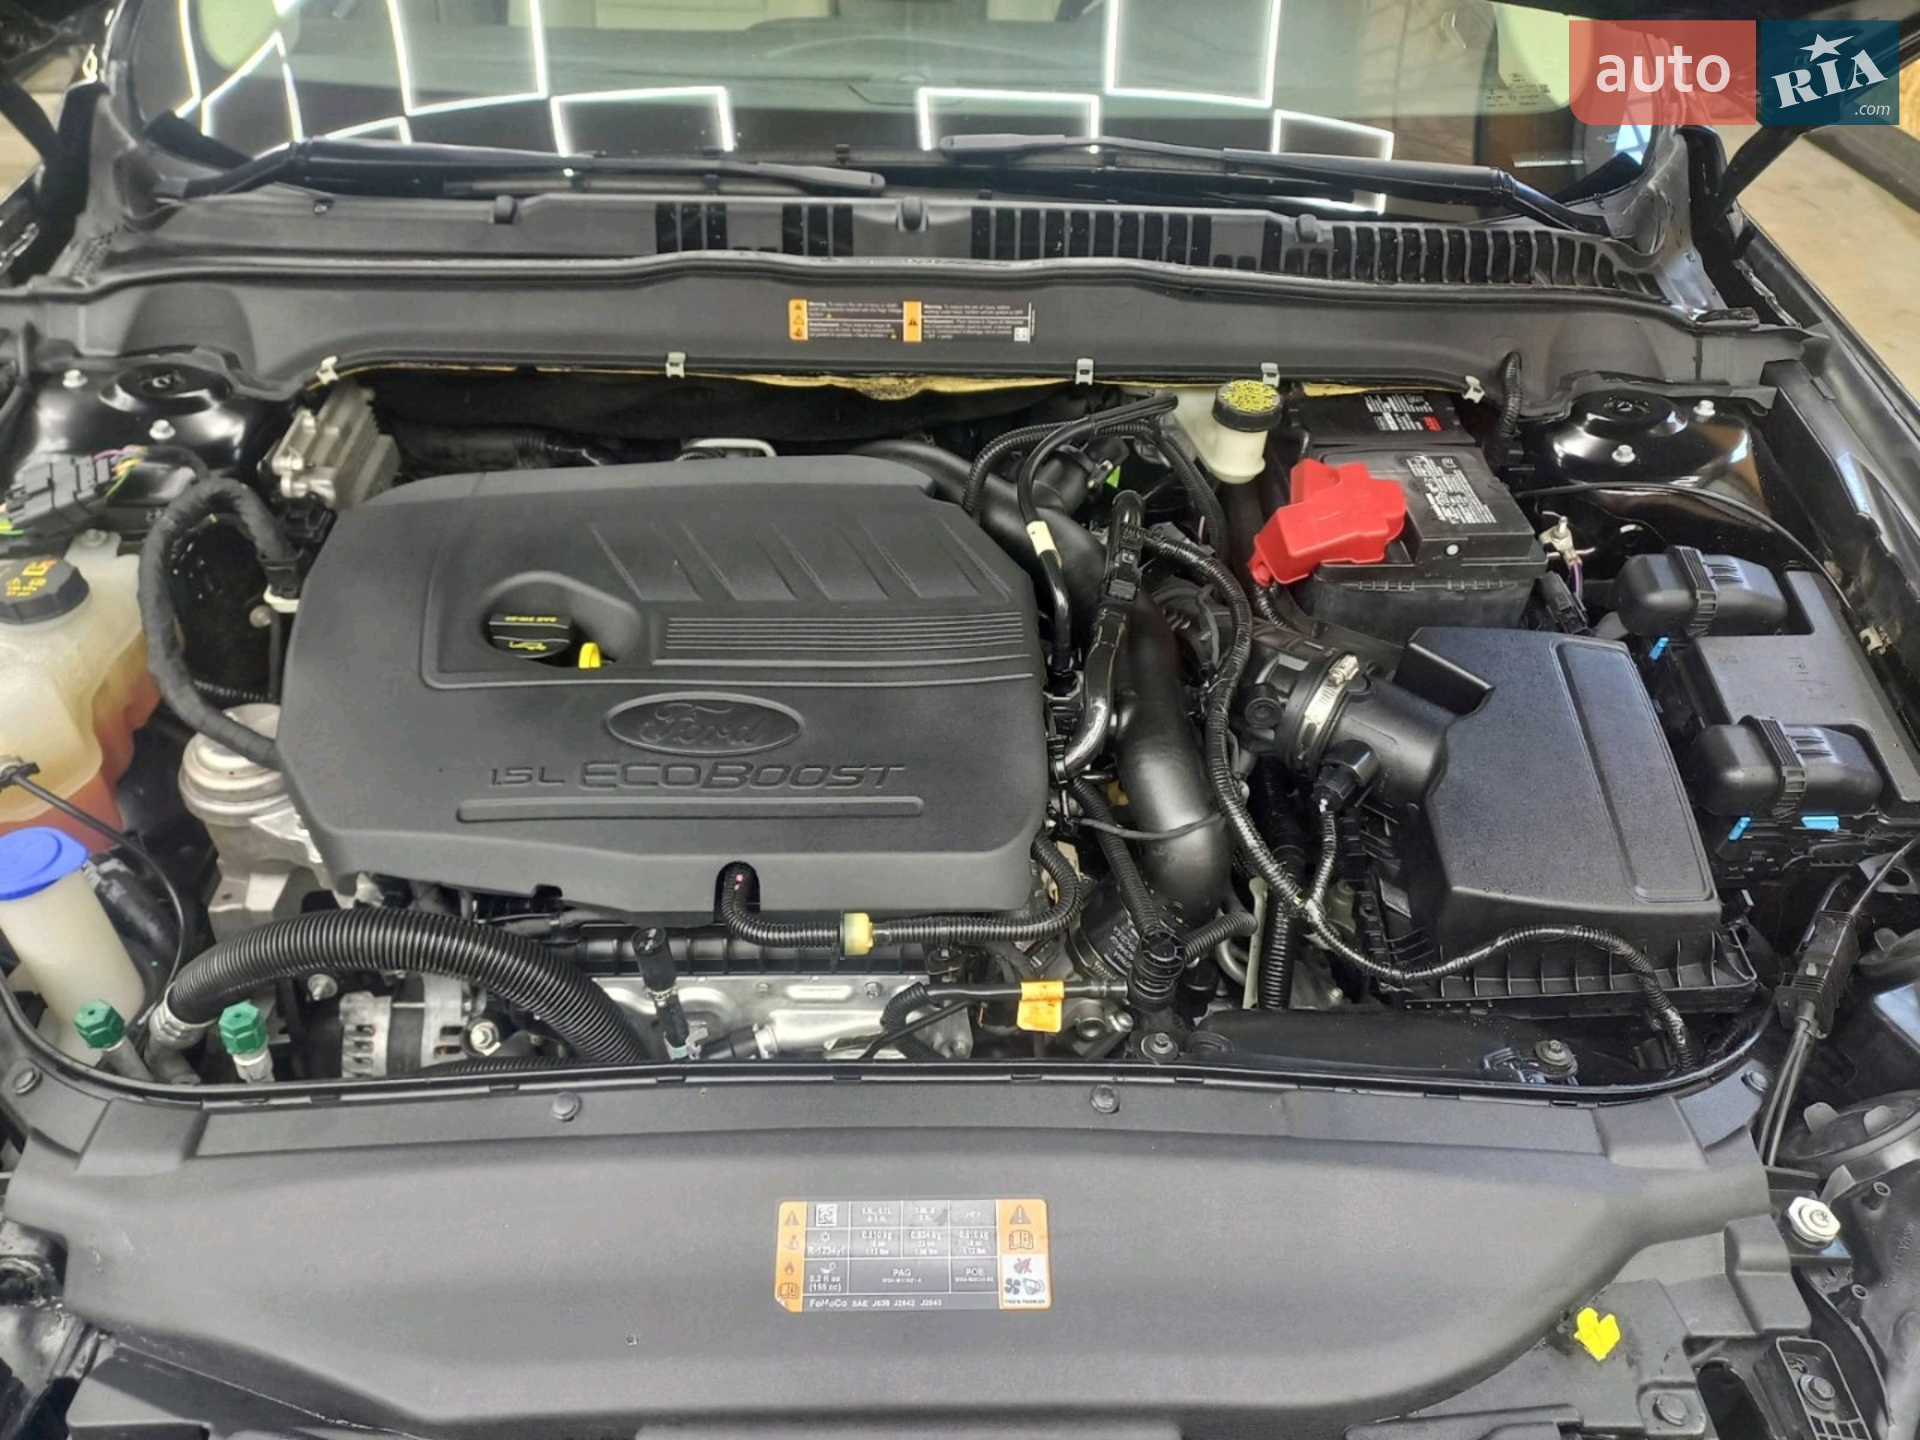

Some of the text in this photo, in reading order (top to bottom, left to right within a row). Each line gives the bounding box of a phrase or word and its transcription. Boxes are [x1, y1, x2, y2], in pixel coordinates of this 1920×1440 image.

[639, 702, 766, 746] Ford
[491, 760, 906, 791] 1.5L ECOBOOST
[892, 1268, 912, 1277] PAG
[965, 1267, 985, 1277] POE
